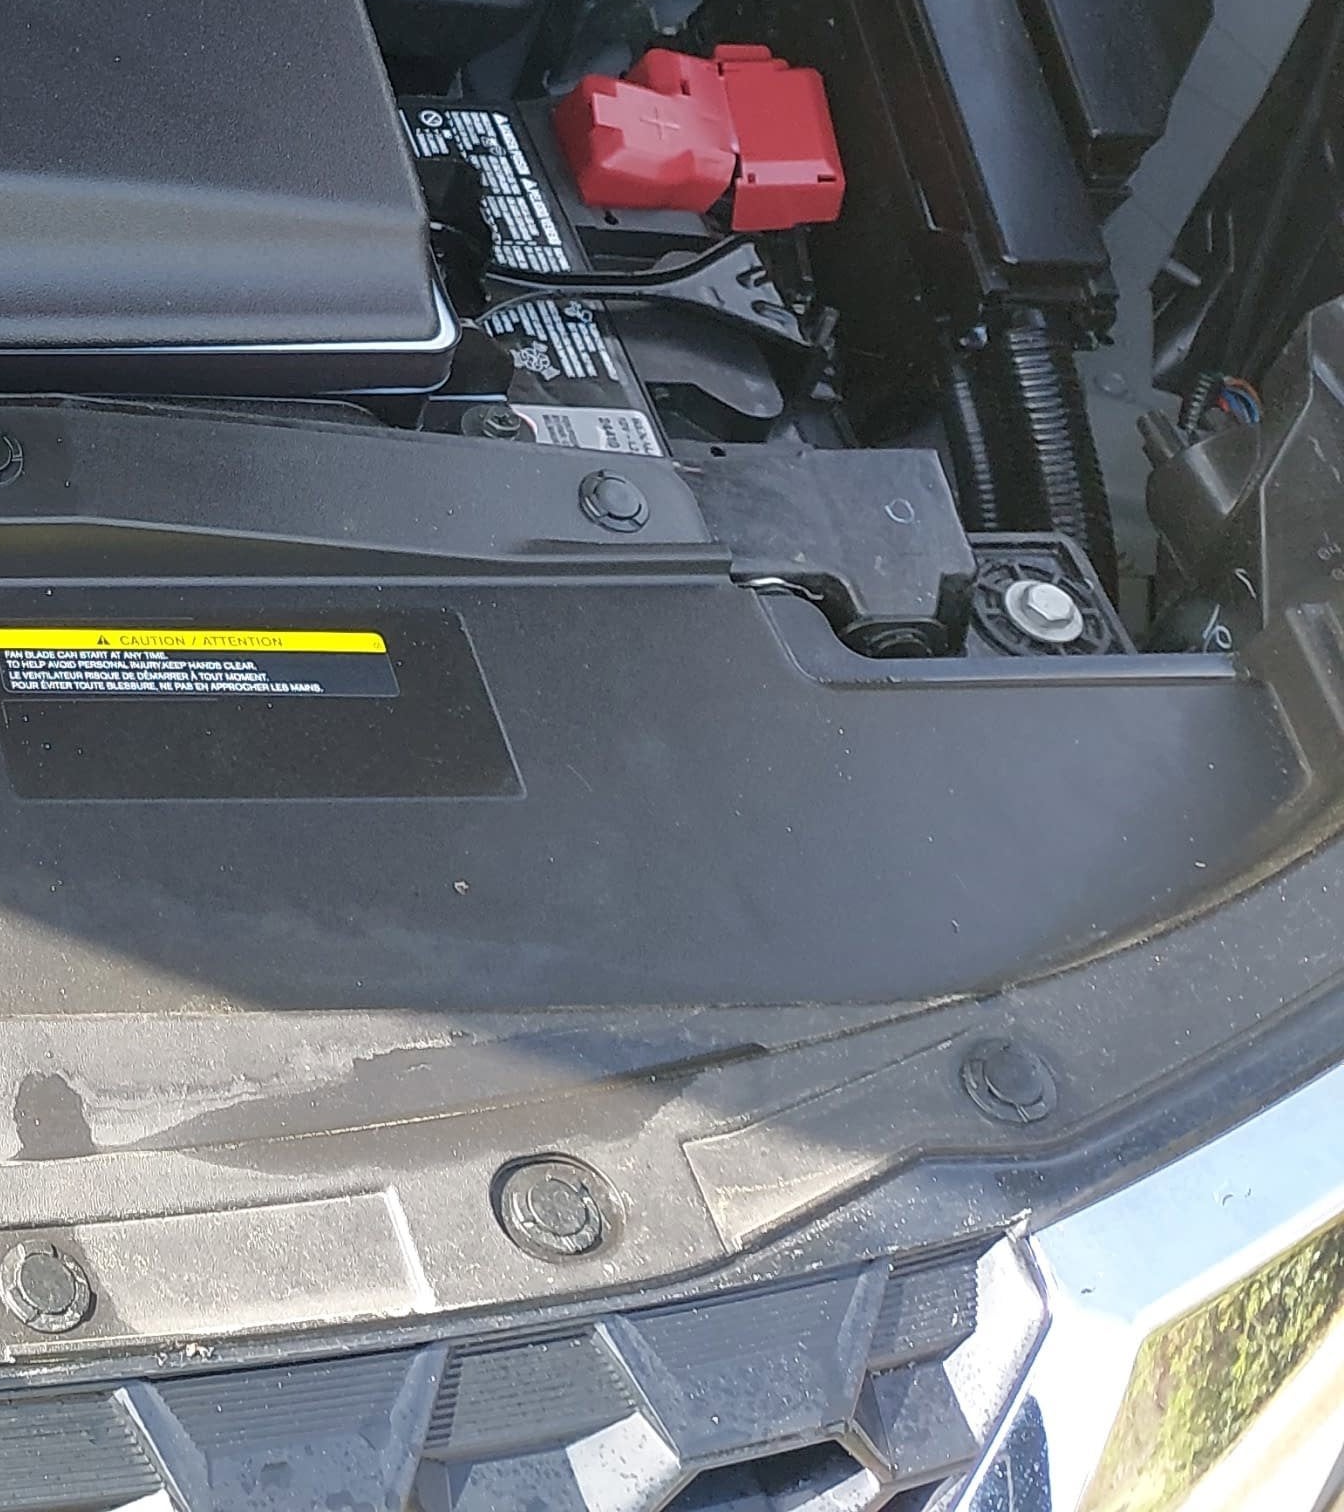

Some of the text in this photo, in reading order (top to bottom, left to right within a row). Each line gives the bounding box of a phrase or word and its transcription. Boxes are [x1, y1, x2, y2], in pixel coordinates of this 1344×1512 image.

[120, 635, 185, 646] CAUTION
[203, 636, 283, 647] ATTENTION
[4, 651, 23, 659] FAN
[24, 651, 55, 659] BLADE
[57, 651, 78, 659] CAN
[80, 651, 108, 659] START
[110, 651, 121, 659] AT
[6, 660, 20, 668] TO
[22, 660, 46, 668] HELP
[48, 660, 76, 669] AVOID
[78, 660, 129, 669] PERSONAL
[189, 661, 222, 670] HANDS
[9, 671, 21, 679] LE
[22, 671, 83, 680] VENTILATEUR
[85, 671, 120, 680] RISQUE
[123, 672, 135, 680] DE
[137, 670, 189, 680] DÉMARRER
[200, 673, 224, 681] TOUT
[12, 681, 39, 689] POUR
[40, 680, 72, 690] ÉVITER
[73, 681, 105, 690] TOUTE
[160, 682, 173, 691] NE
[175, 682, 193, 691] PAS
[195, 683, 209, 692] EN
[211, 683, 270, 692] APPROCHER
[270, 683, 290, 692] LES
